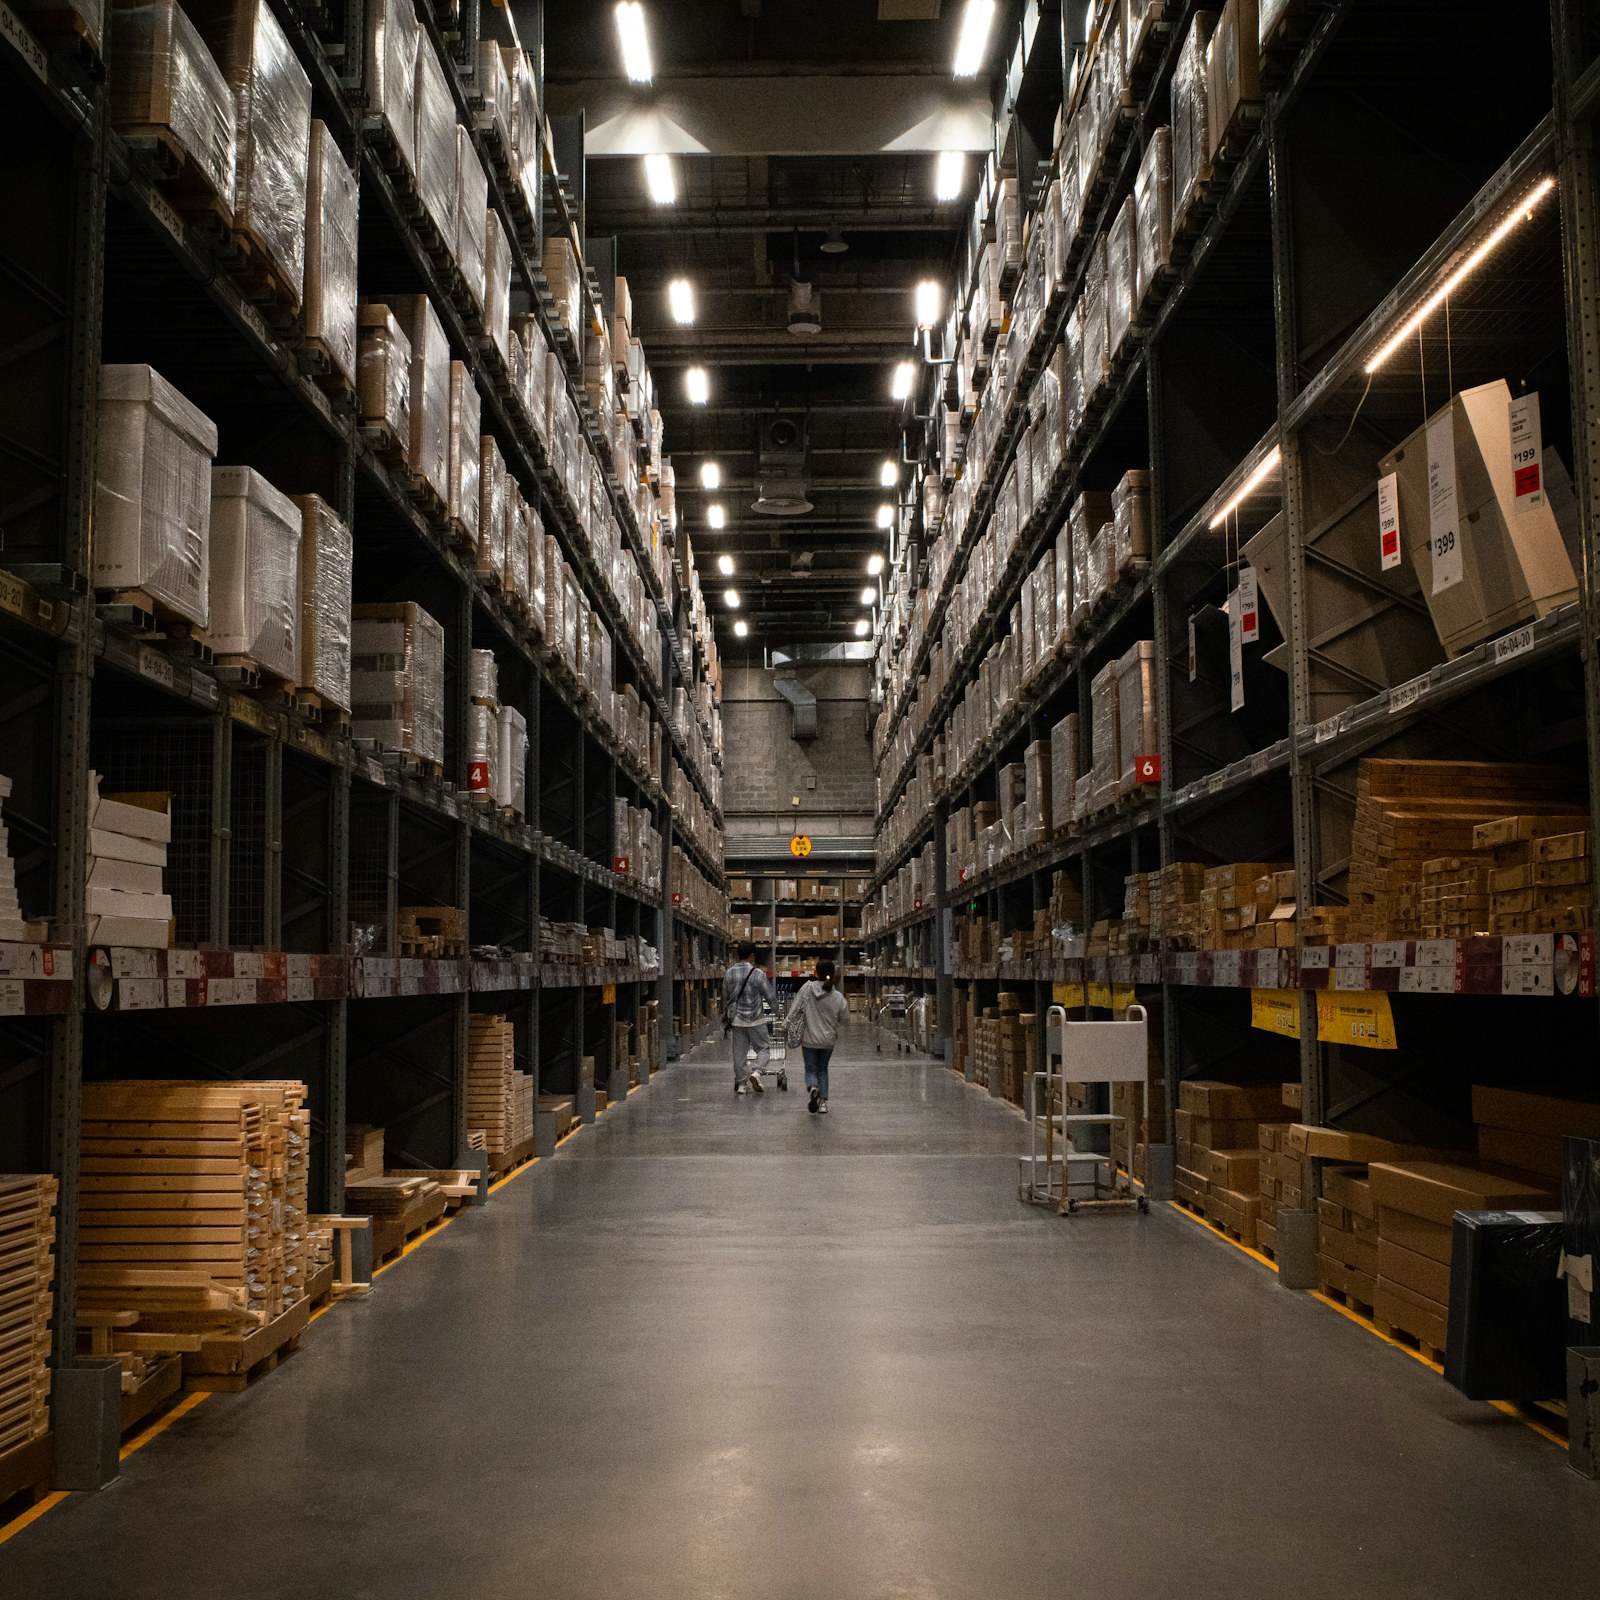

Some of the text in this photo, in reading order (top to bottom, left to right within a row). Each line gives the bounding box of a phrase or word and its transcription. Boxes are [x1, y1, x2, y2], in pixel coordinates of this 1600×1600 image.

[1513, 448, 1535, 464] ¥199
[1434, 531, 1455, 556] ¥399
[1498, 631, 1530, 657] 06-04-20
[471, 767, 482, 782] 4
[1142, 761, 1154, 776] 6
[618, 860, 626, 869] 4
